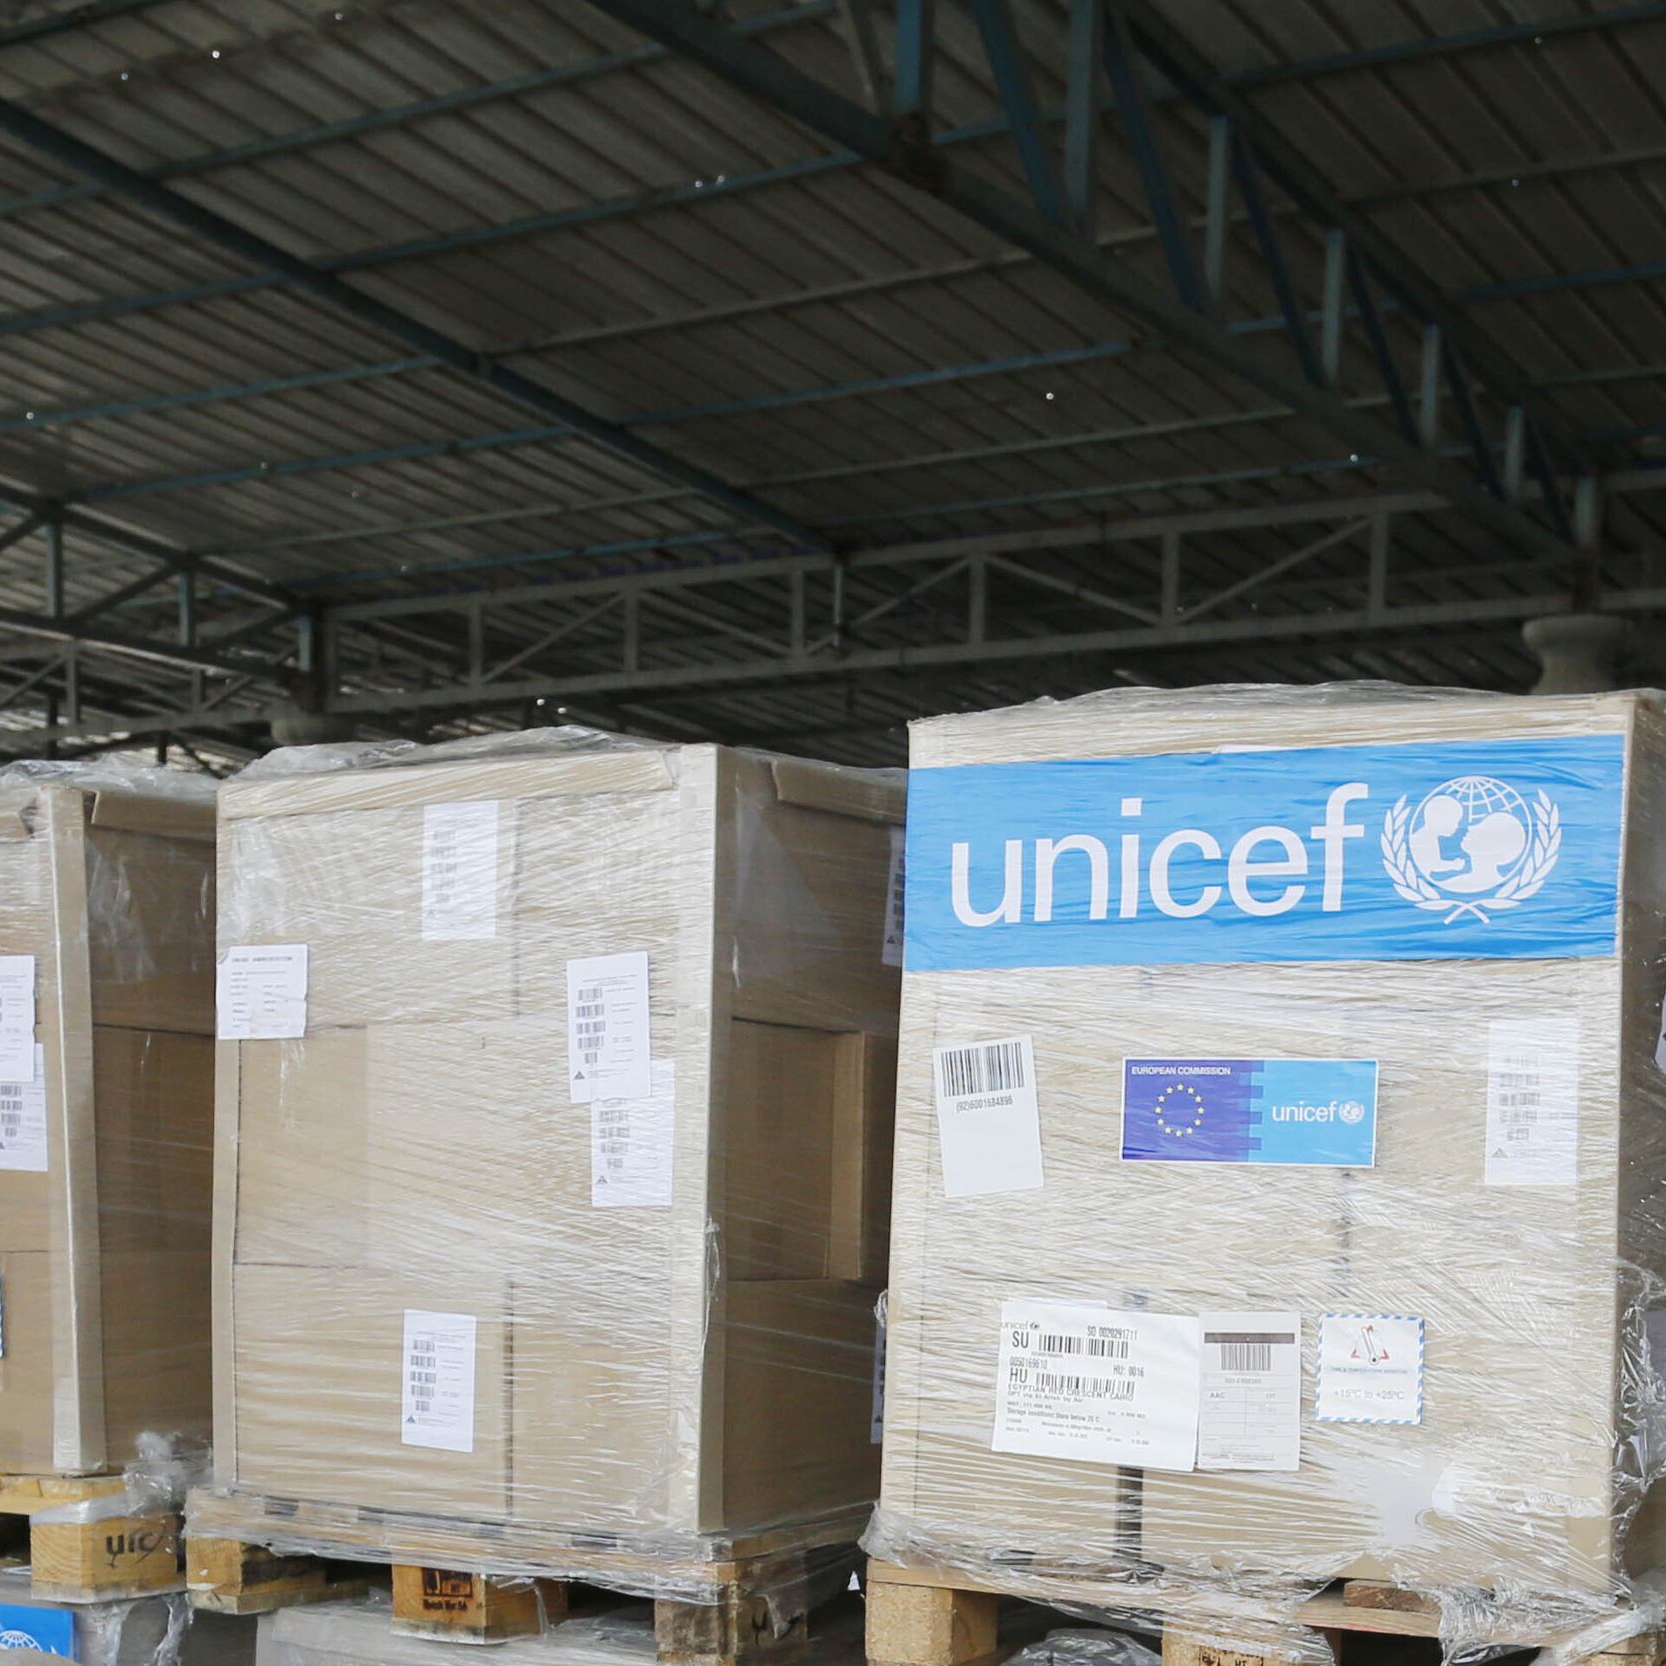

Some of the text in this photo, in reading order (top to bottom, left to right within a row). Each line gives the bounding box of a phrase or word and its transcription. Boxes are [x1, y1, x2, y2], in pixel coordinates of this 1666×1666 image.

[952, 783, 1368, 926] unicef
[1132, 1067, 1231, 1076] EUROPEAN COMMISSION
[1272, 1101, 1337, 1122] unicef
[1012, 1331, 1030, 1348] SU
[1009, 1368, 1028, 1383] HU
